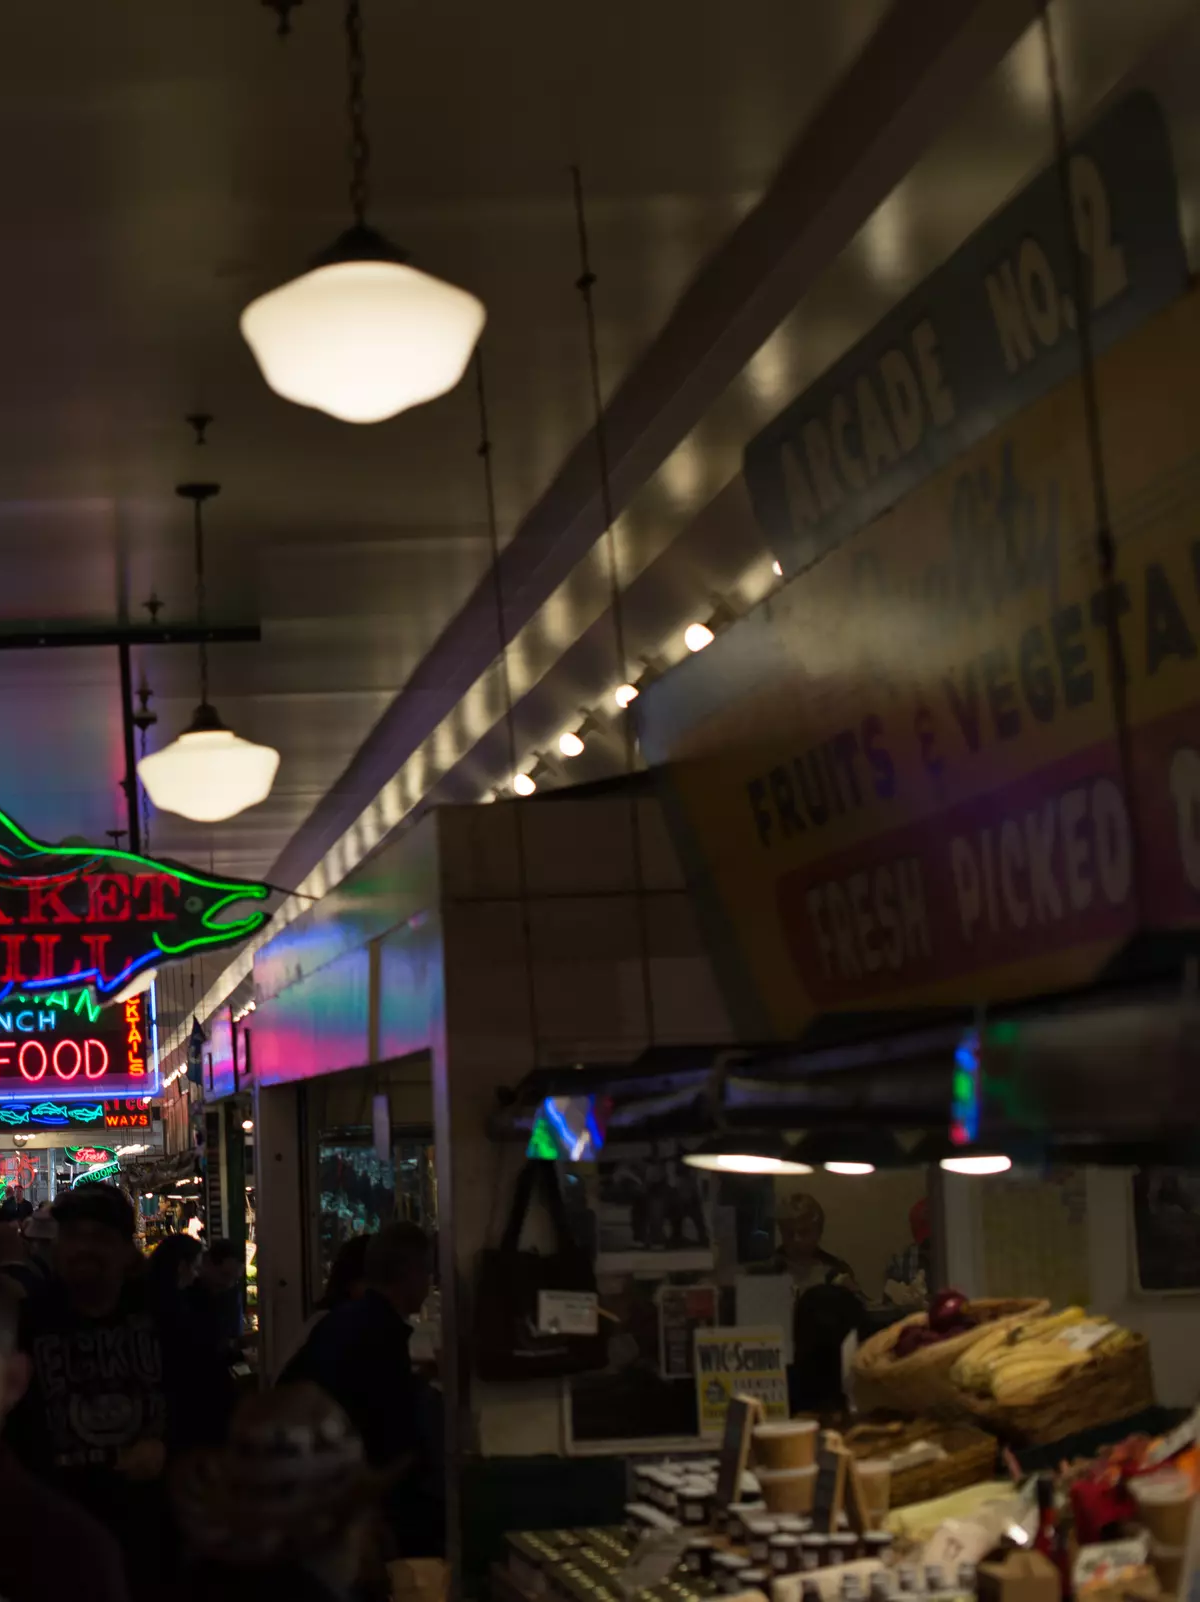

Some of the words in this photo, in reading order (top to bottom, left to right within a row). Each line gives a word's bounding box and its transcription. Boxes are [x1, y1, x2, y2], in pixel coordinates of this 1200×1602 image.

[779, 318, 955, 536] ARCADE
[1067, 153, 1128, 309] 2
[744, 714, 896, 848] FRUITS
[943, 540, 1200, 752] VEGETA
[804, 856, 933, 980] FRESH
[949, 776, 1133, 944] PICKED
